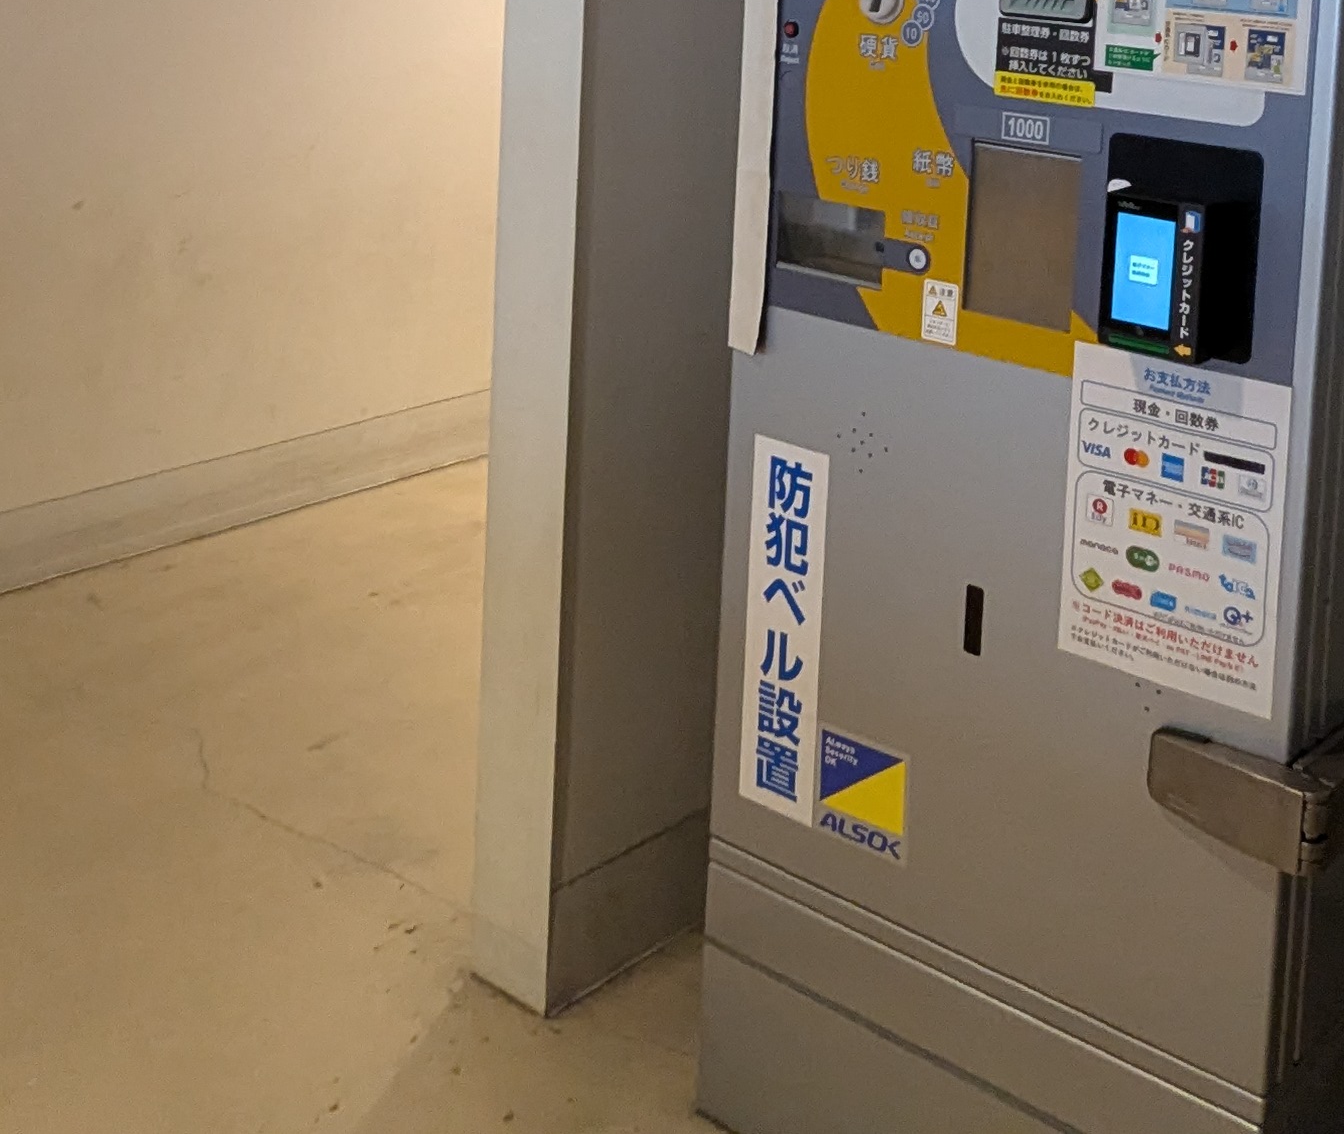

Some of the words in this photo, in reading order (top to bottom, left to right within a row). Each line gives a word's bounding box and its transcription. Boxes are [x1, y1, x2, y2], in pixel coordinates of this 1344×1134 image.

[917, 10, 930, 24] 50
[859, 34, 898, 61] 硬貨
[906, 27, 917, 40] 10
[1007, 117, 1044, 140] 1000
[825, 155, 880, 184] つり銭
[912, 148, 954, 177] 紙幣
[1179, 239, 1195, 339] クレジットカード
[1144, 367, 1211, 396] お支払方法
[1133, 398, 1219, 431] 現金・回数券
[1081, 440, 1111, 459] VISA
[1088, 417, 1200, 455] クレジットカード
[1102, 479, 1244, 530] 電子マネー・交通系IC
[756, 455, 813, 803] 防犯ベル設置
[824, 756, 837, 767] OK
[820, 812, 901, 860] ALSOK
